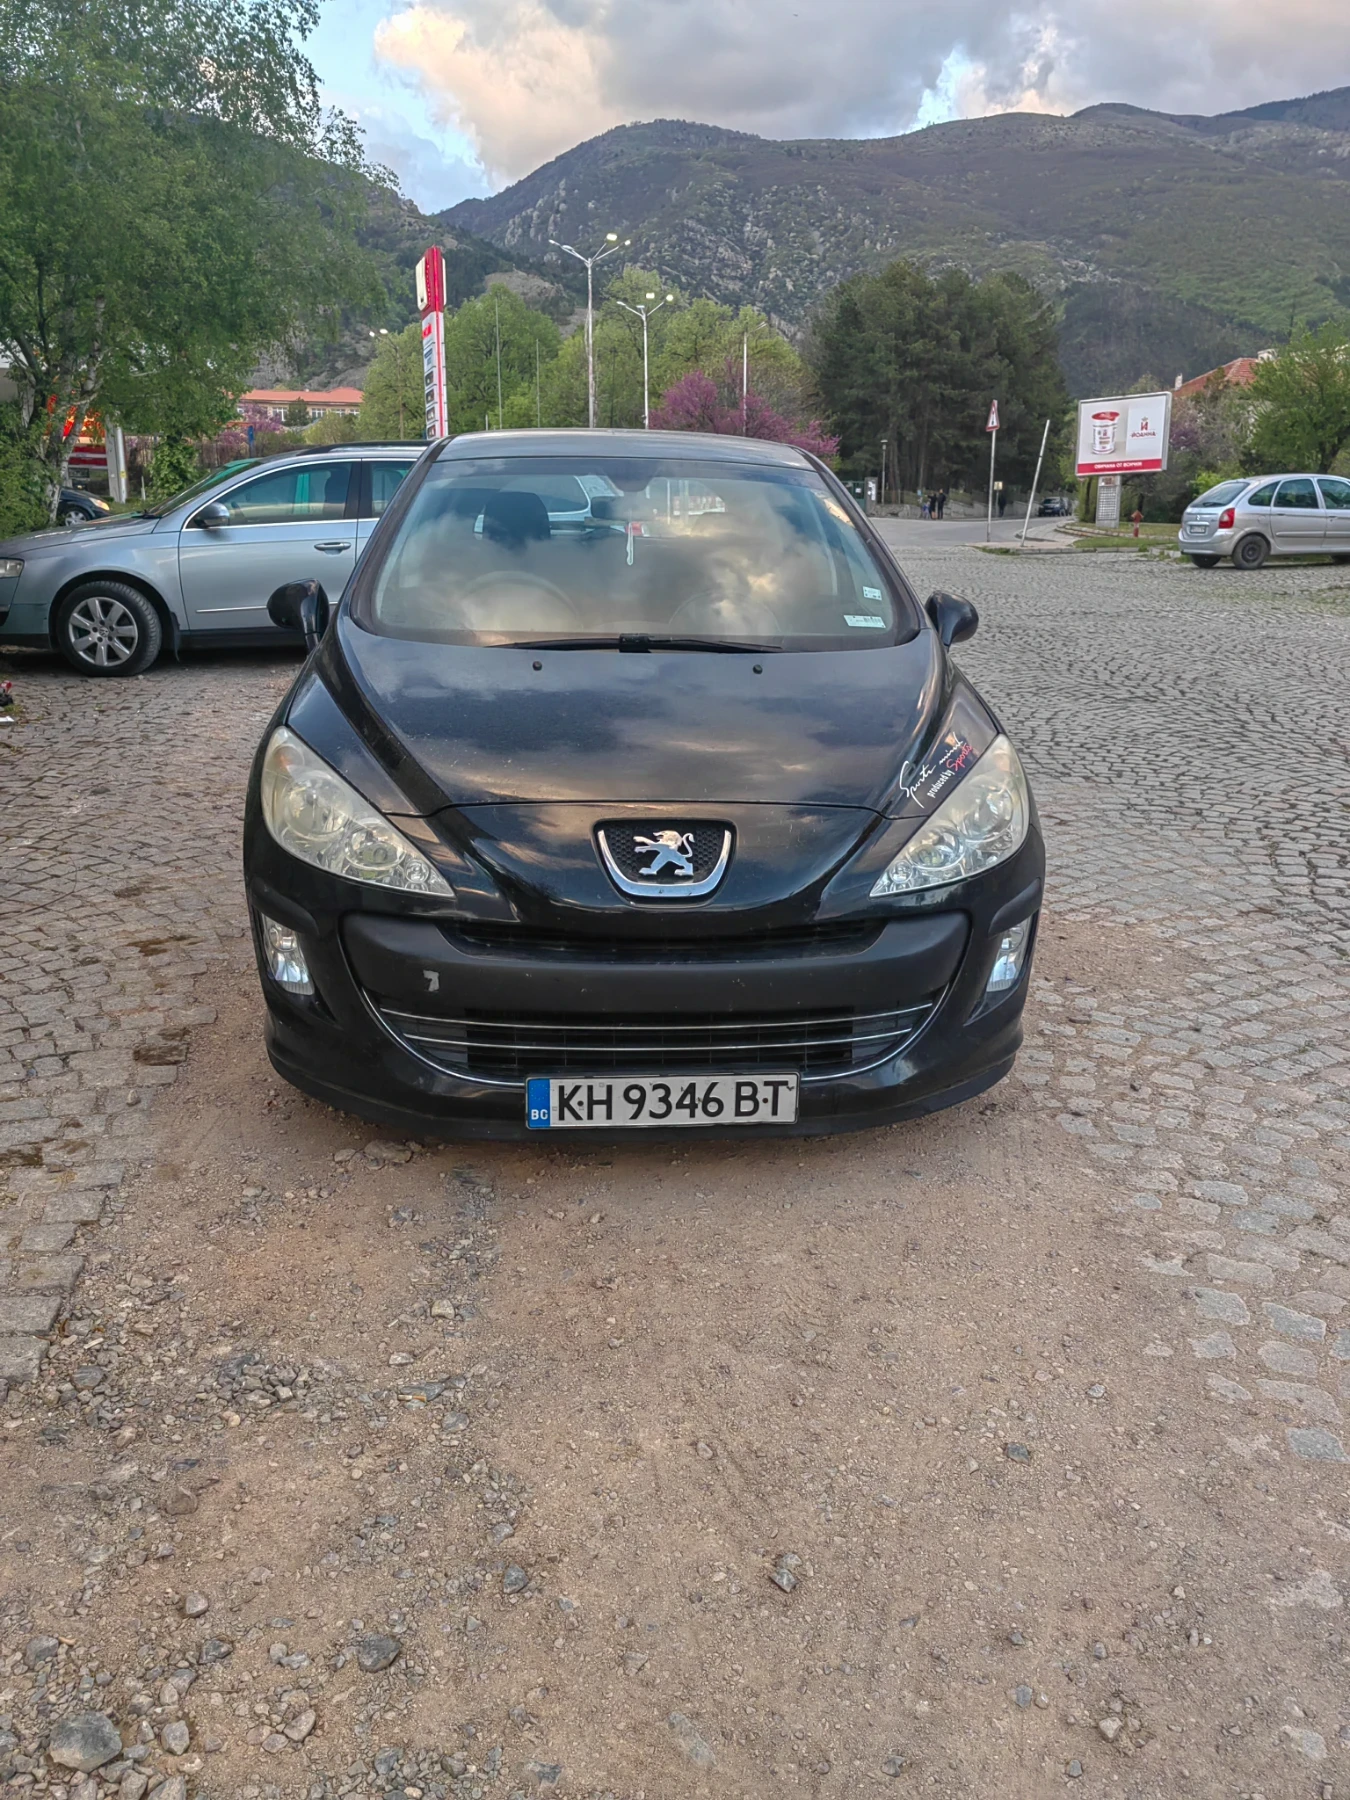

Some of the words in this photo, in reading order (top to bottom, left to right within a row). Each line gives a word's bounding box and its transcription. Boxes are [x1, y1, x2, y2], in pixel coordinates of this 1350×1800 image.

[927, 773, 949, 798] produced
[558, 1084, 612, 1121] KH
[623, 1082, 724, 1120] 9346
[734, 1080, 788, 1118] BT
